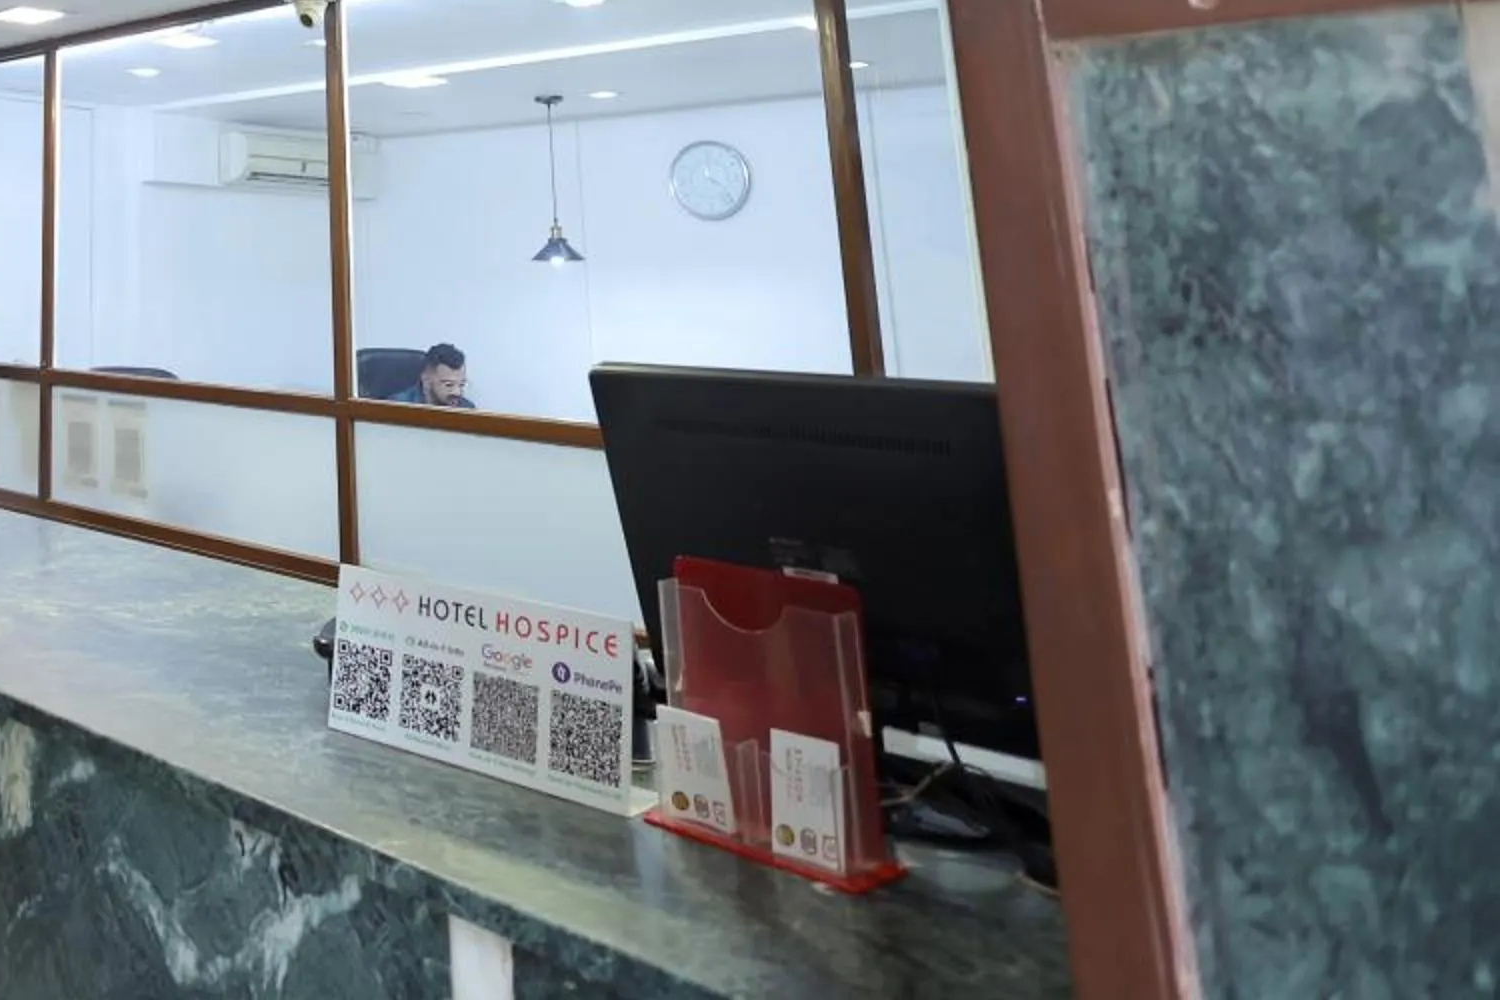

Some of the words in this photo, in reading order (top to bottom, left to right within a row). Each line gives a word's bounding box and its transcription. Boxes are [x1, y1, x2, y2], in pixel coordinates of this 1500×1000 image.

[417, 595, 489, 631] HOTEL
[495, 611, 619, 658] HOSPICE
[481, 642, 534, 671] Google
[573, 671, 623, 695] PhonePe
